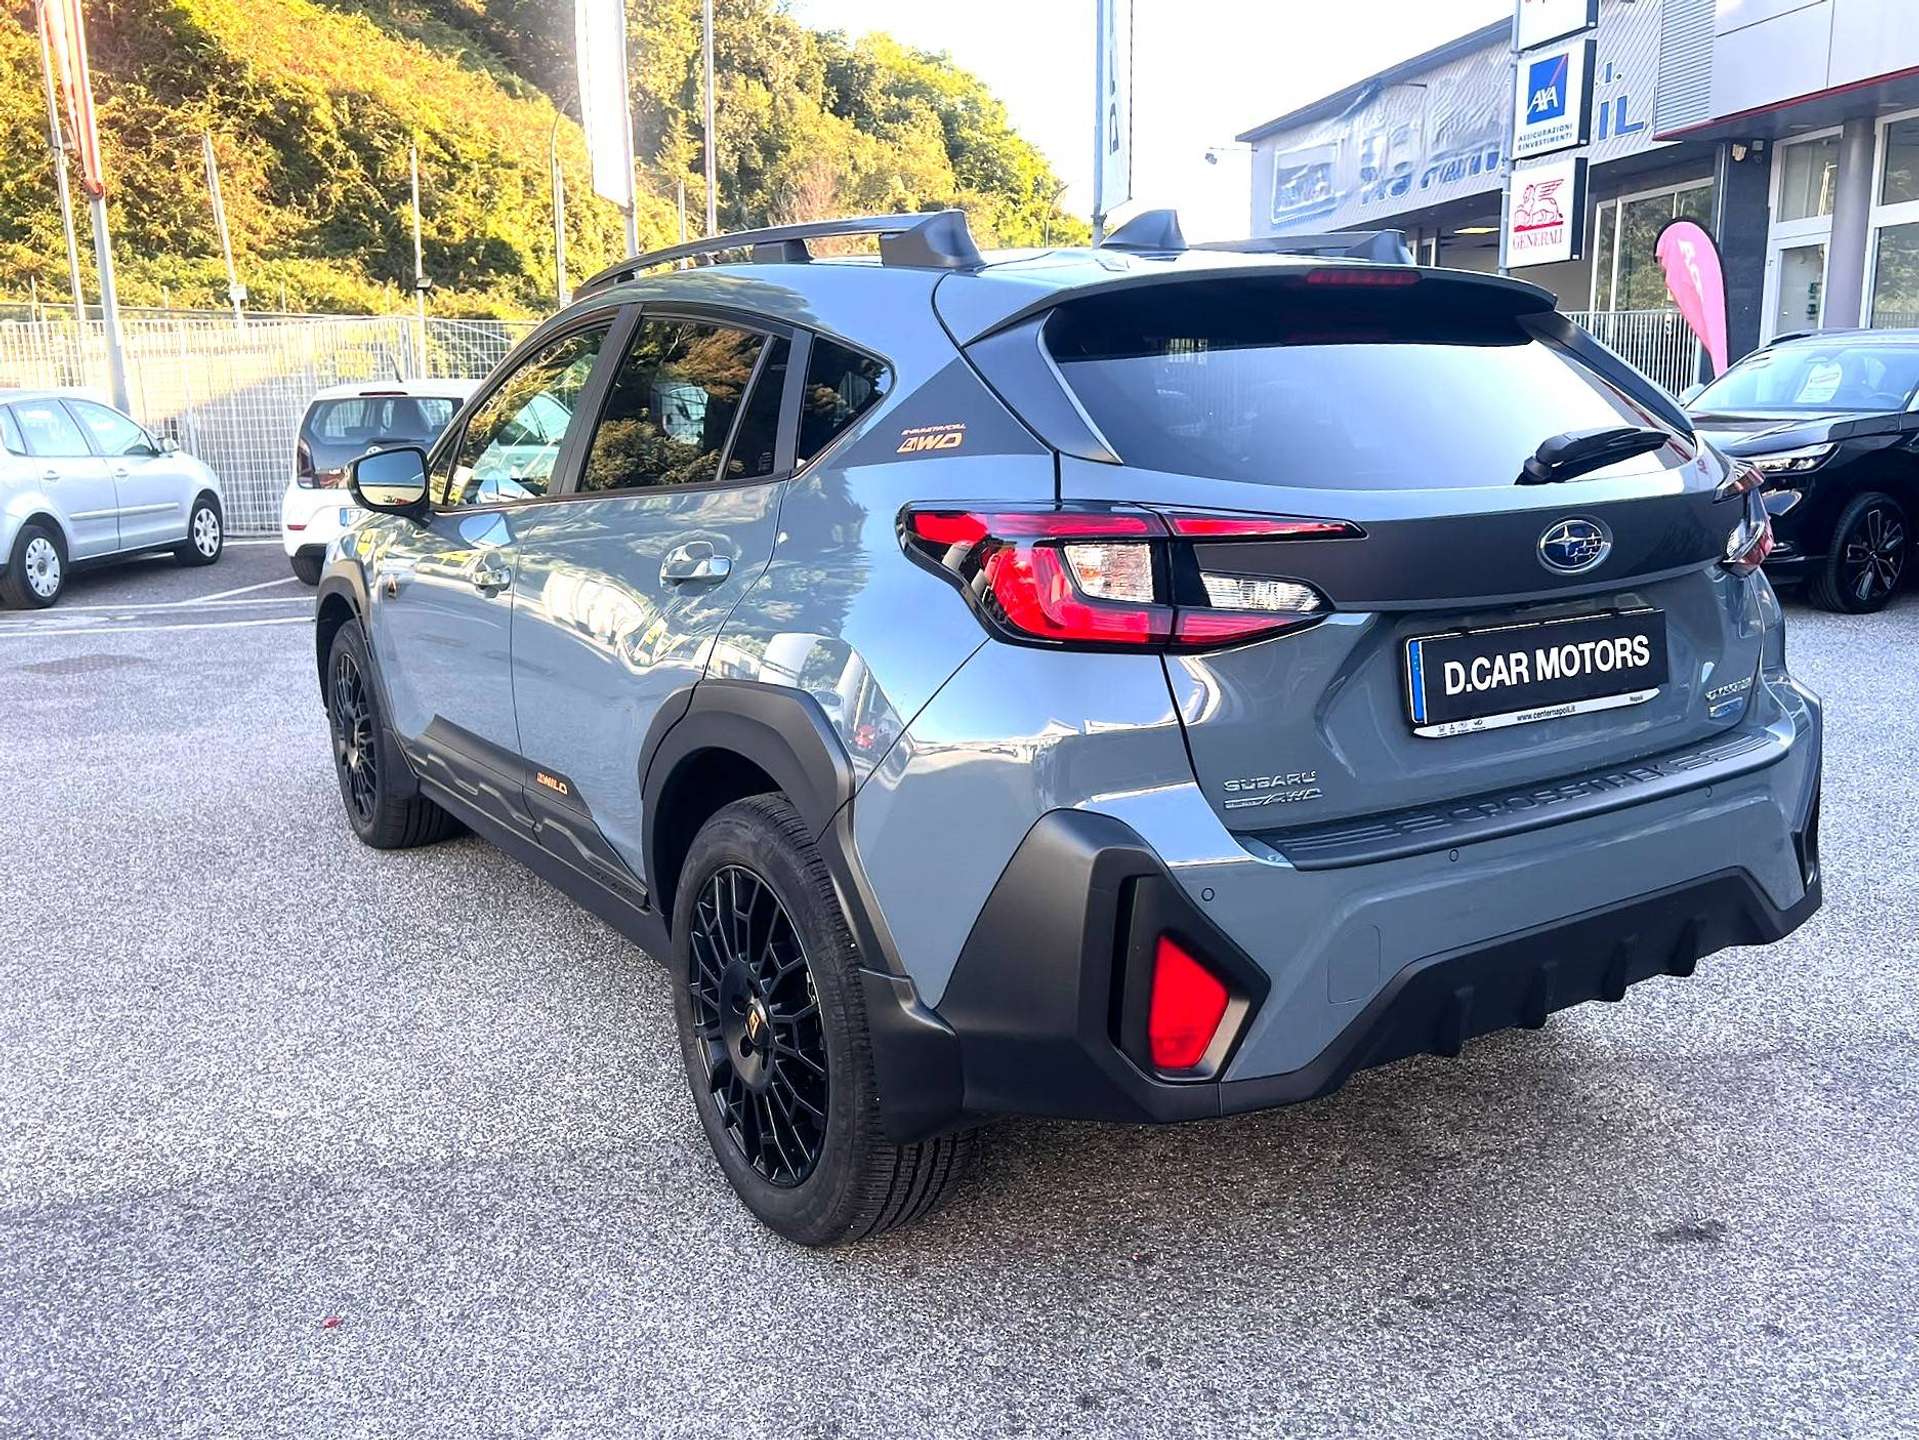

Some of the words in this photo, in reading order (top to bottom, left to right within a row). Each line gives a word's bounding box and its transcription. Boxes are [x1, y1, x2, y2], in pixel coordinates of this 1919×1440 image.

[1526, 86, 1559, 117] AXA
[1518, 123, 1573, 142] ASSICURAZIONI
[1512, 228, 1563, 250] GENERALI
[1443, 650, 1530, 696] D.CAR
[1535, 634, 1651, 682] MOTORS
[1223, 770, 1317, 792] SUBARU
